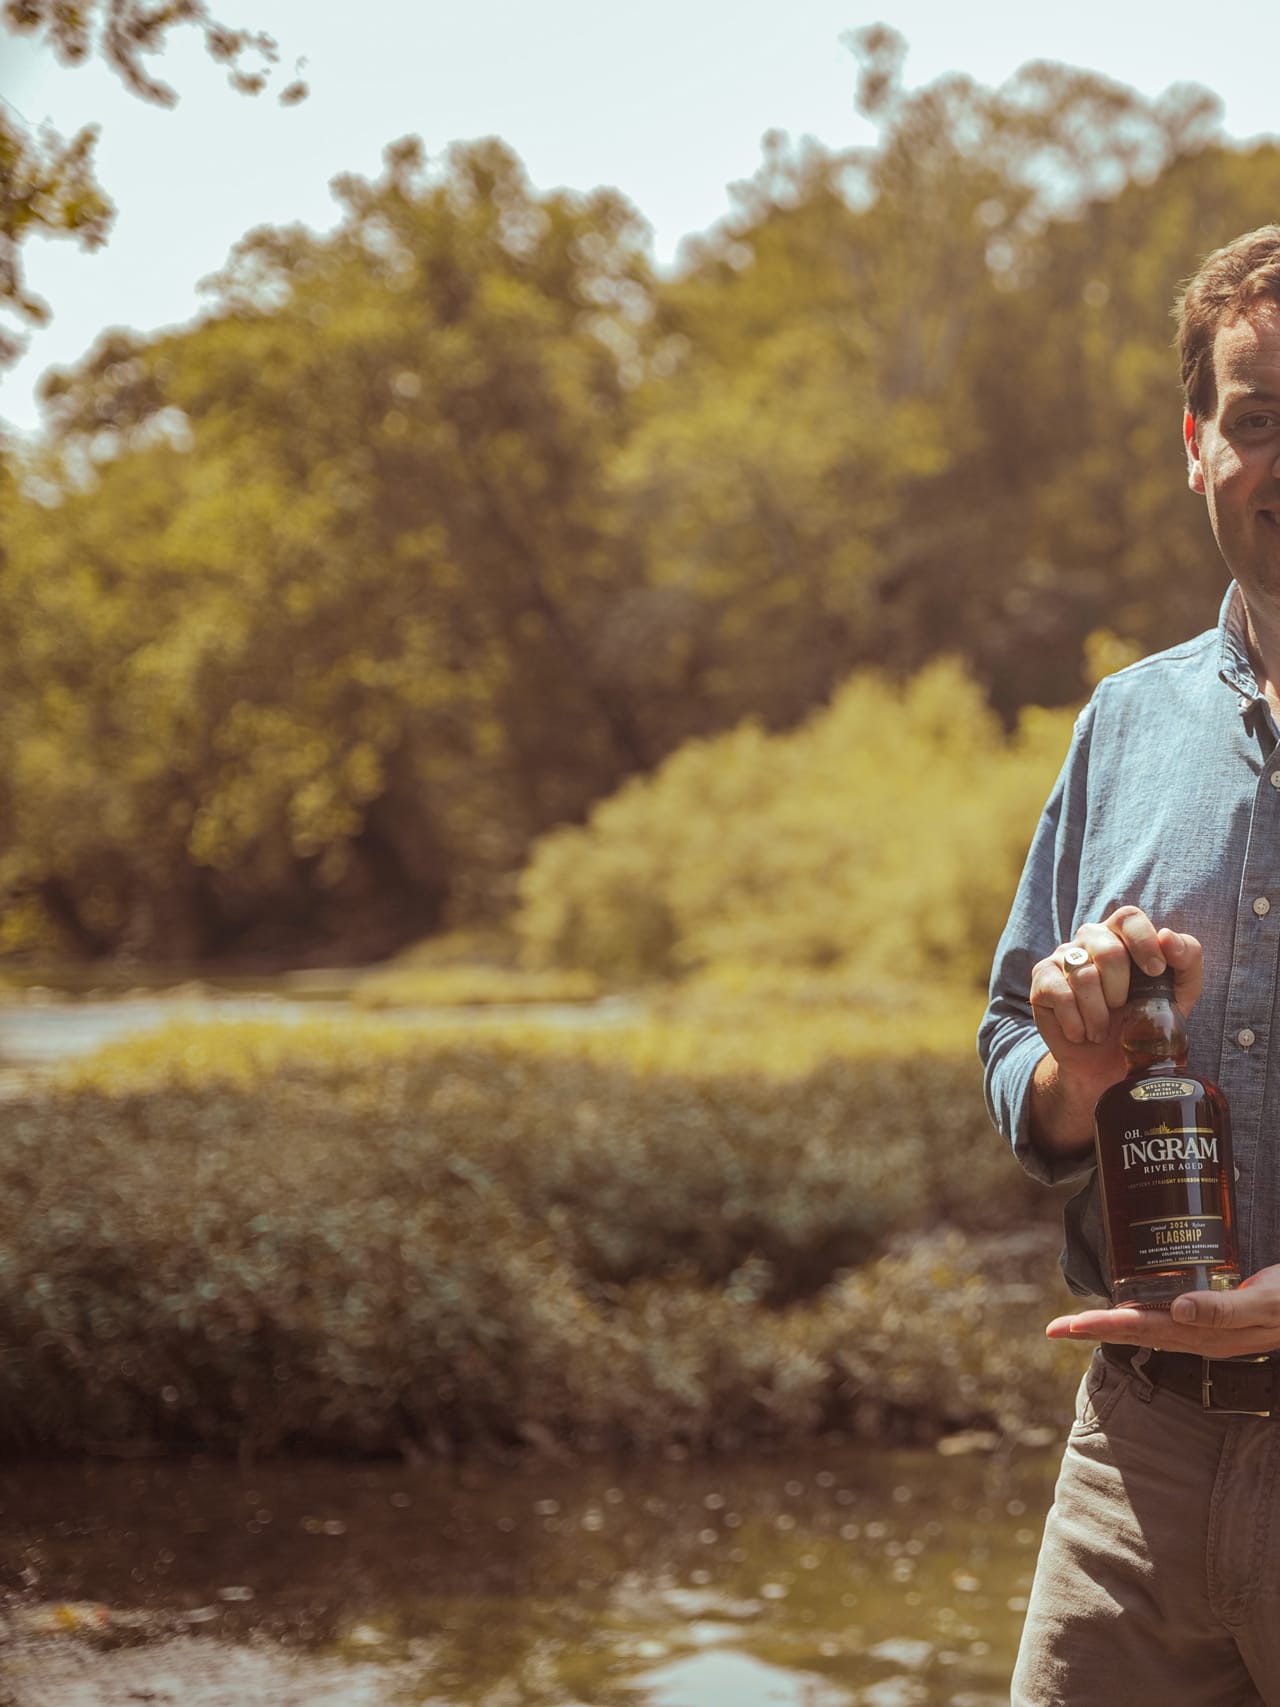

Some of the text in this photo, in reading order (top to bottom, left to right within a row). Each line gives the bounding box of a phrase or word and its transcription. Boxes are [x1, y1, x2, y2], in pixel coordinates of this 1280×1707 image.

[1124, 1129, 1143, 1140] O.H.
[1121, 1137, 1219, 1170] INGRAM
[1144, 1162, 1203, 1174] RIVER AGED
[1170, 1221, 1189, 1229] 2024
[1156, 1229, 1202, 1245] FLAGSHIP
